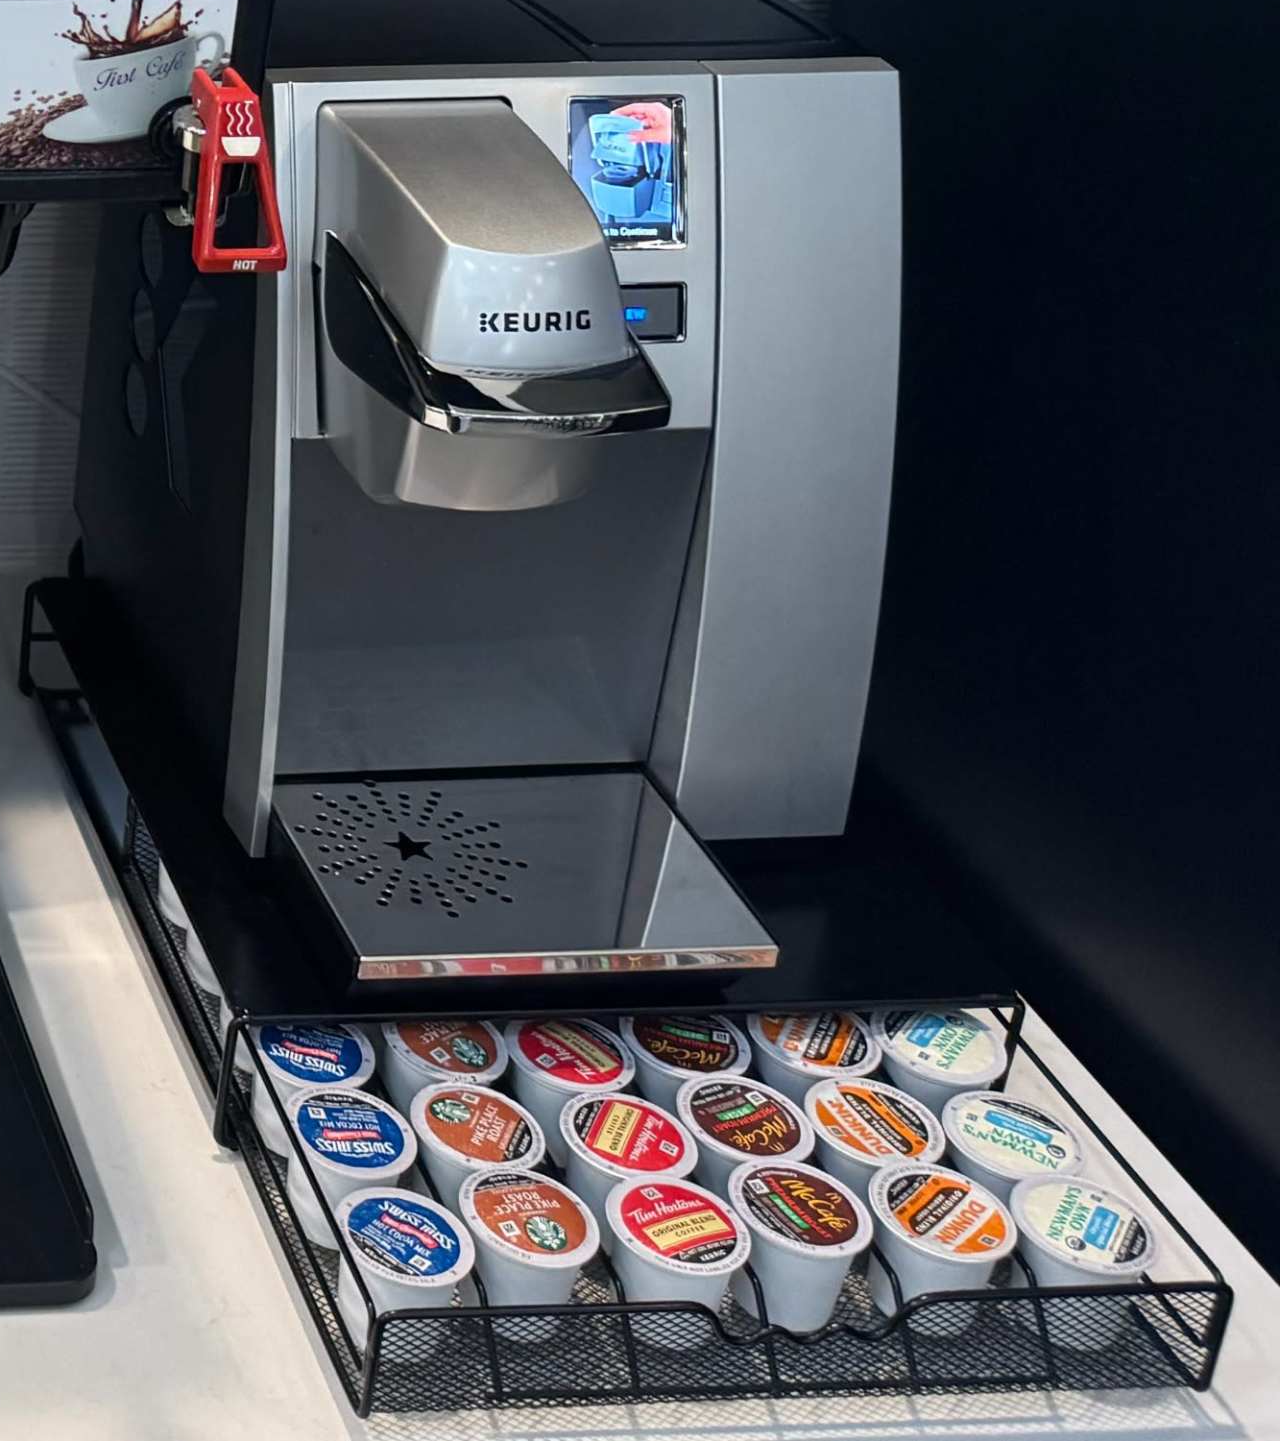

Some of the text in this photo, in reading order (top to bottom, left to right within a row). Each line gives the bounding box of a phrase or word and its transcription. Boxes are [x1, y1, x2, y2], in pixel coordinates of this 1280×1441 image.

[233, 260, 258, 271] HOT
[479, 310, 591, 333] KEURIG
[627, 1208, 656, 1224] Tim
